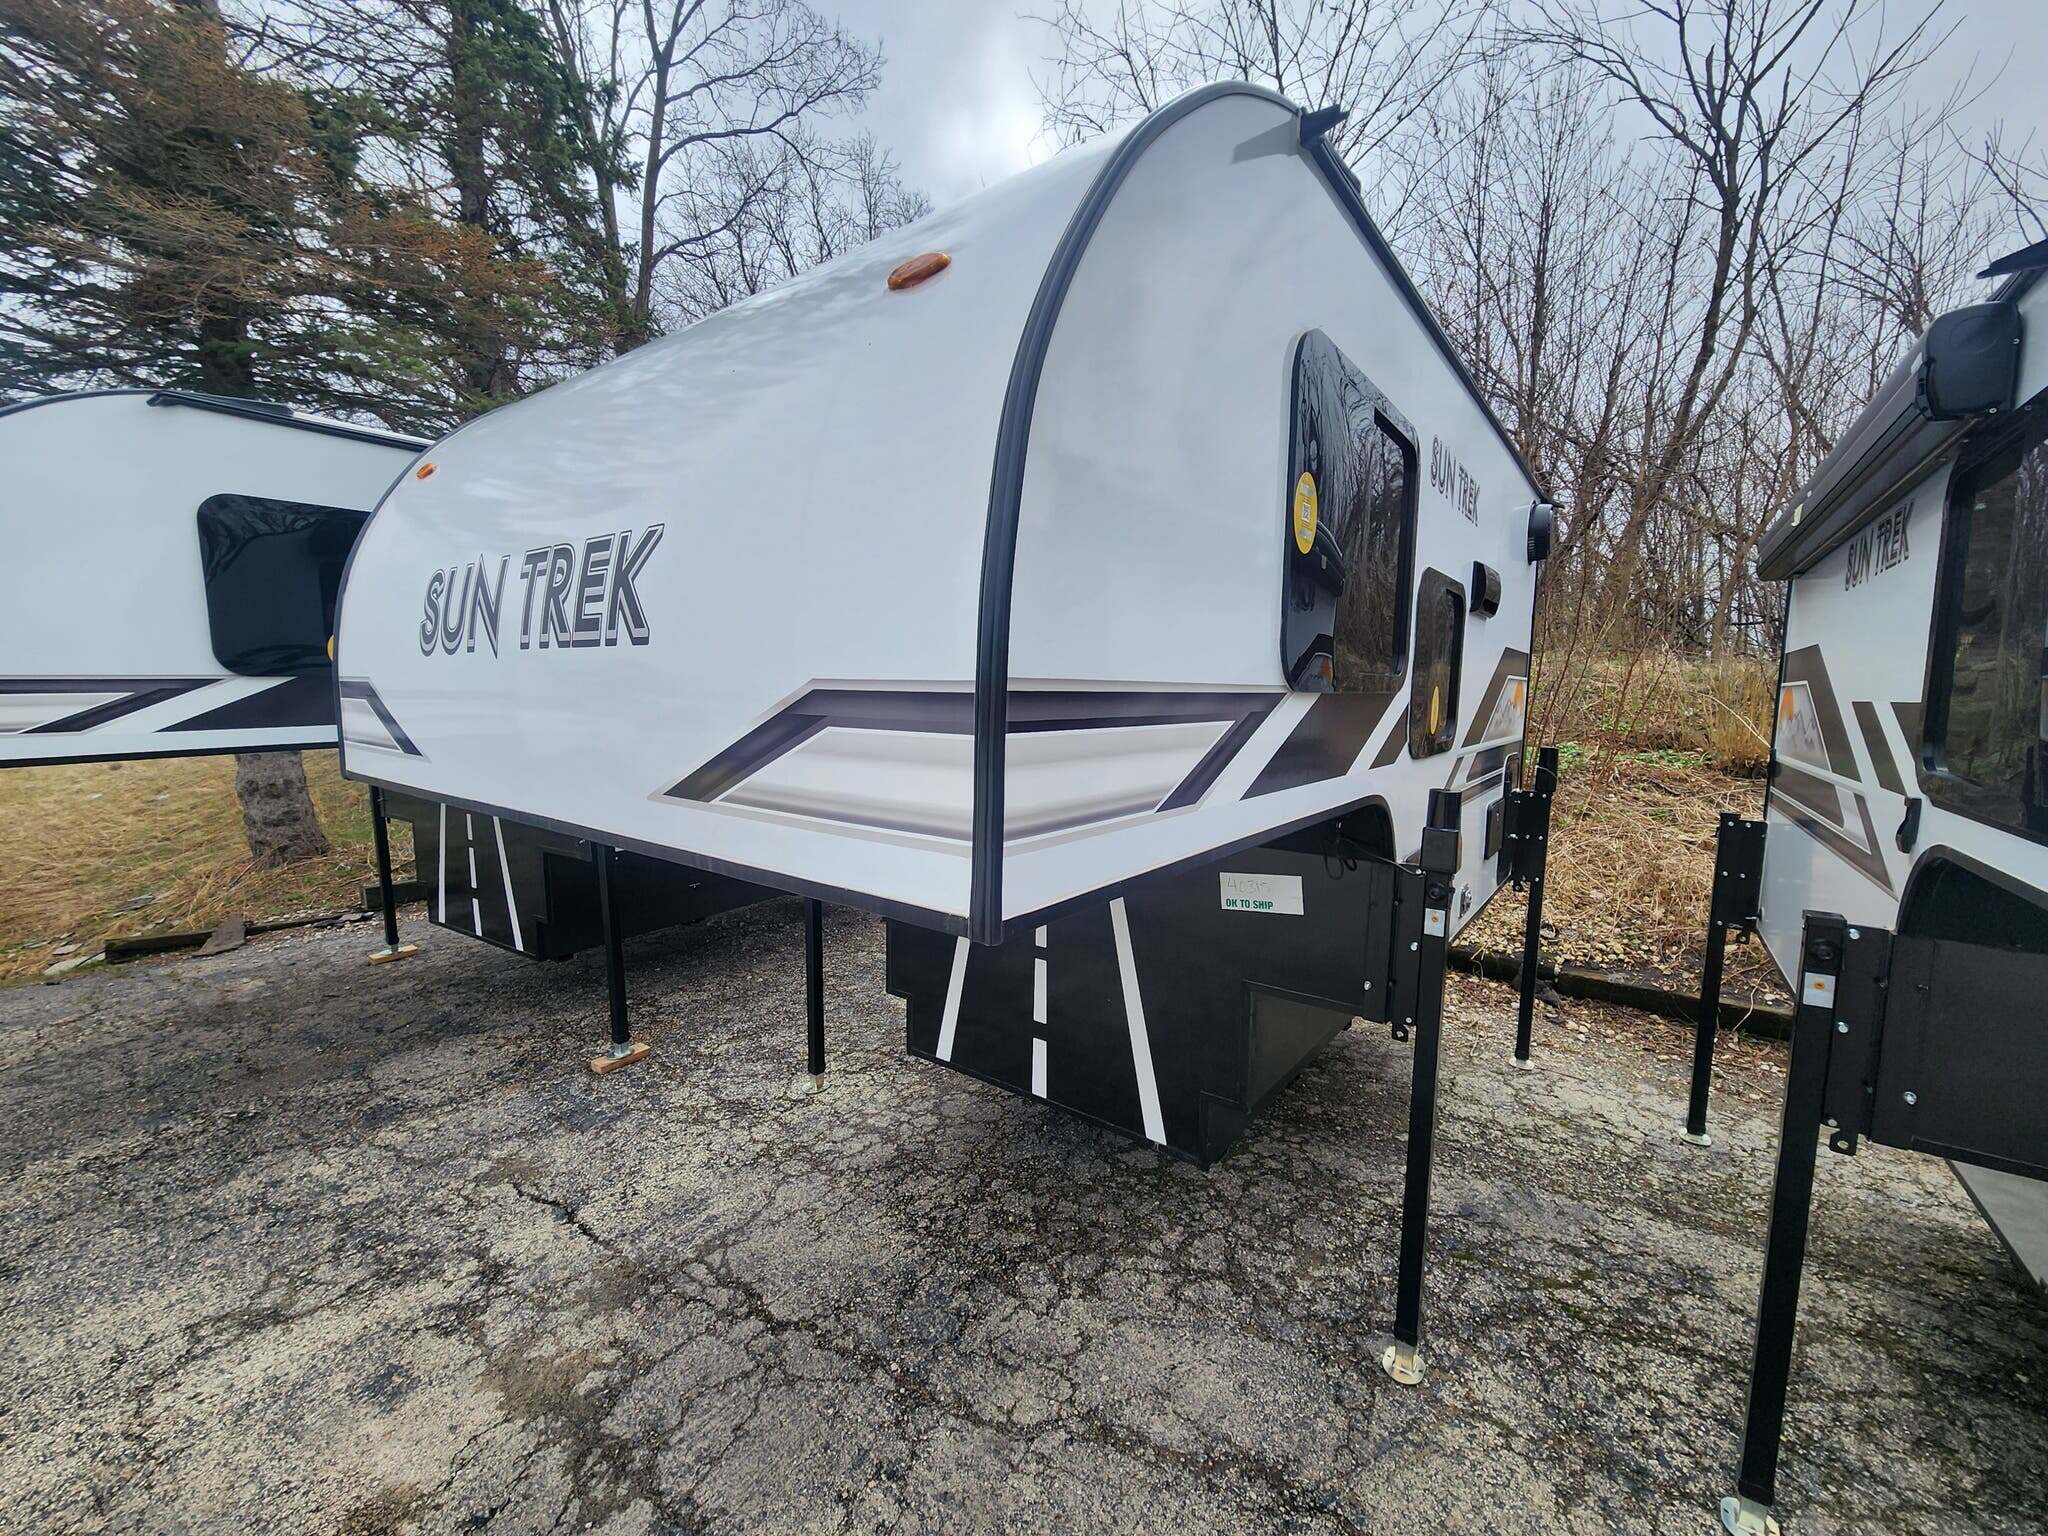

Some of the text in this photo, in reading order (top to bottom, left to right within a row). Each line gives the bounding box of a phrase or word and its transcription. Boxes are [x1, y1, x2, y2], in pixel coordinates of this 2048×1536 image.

[1431, 434, 1480, 527] SUN TREK
[420, 523, 665, 659] SUN TREK
[1845, 501, 1914, 591] SUN TREK
[1226, 898, 1273, 910] OK TO SHIP
